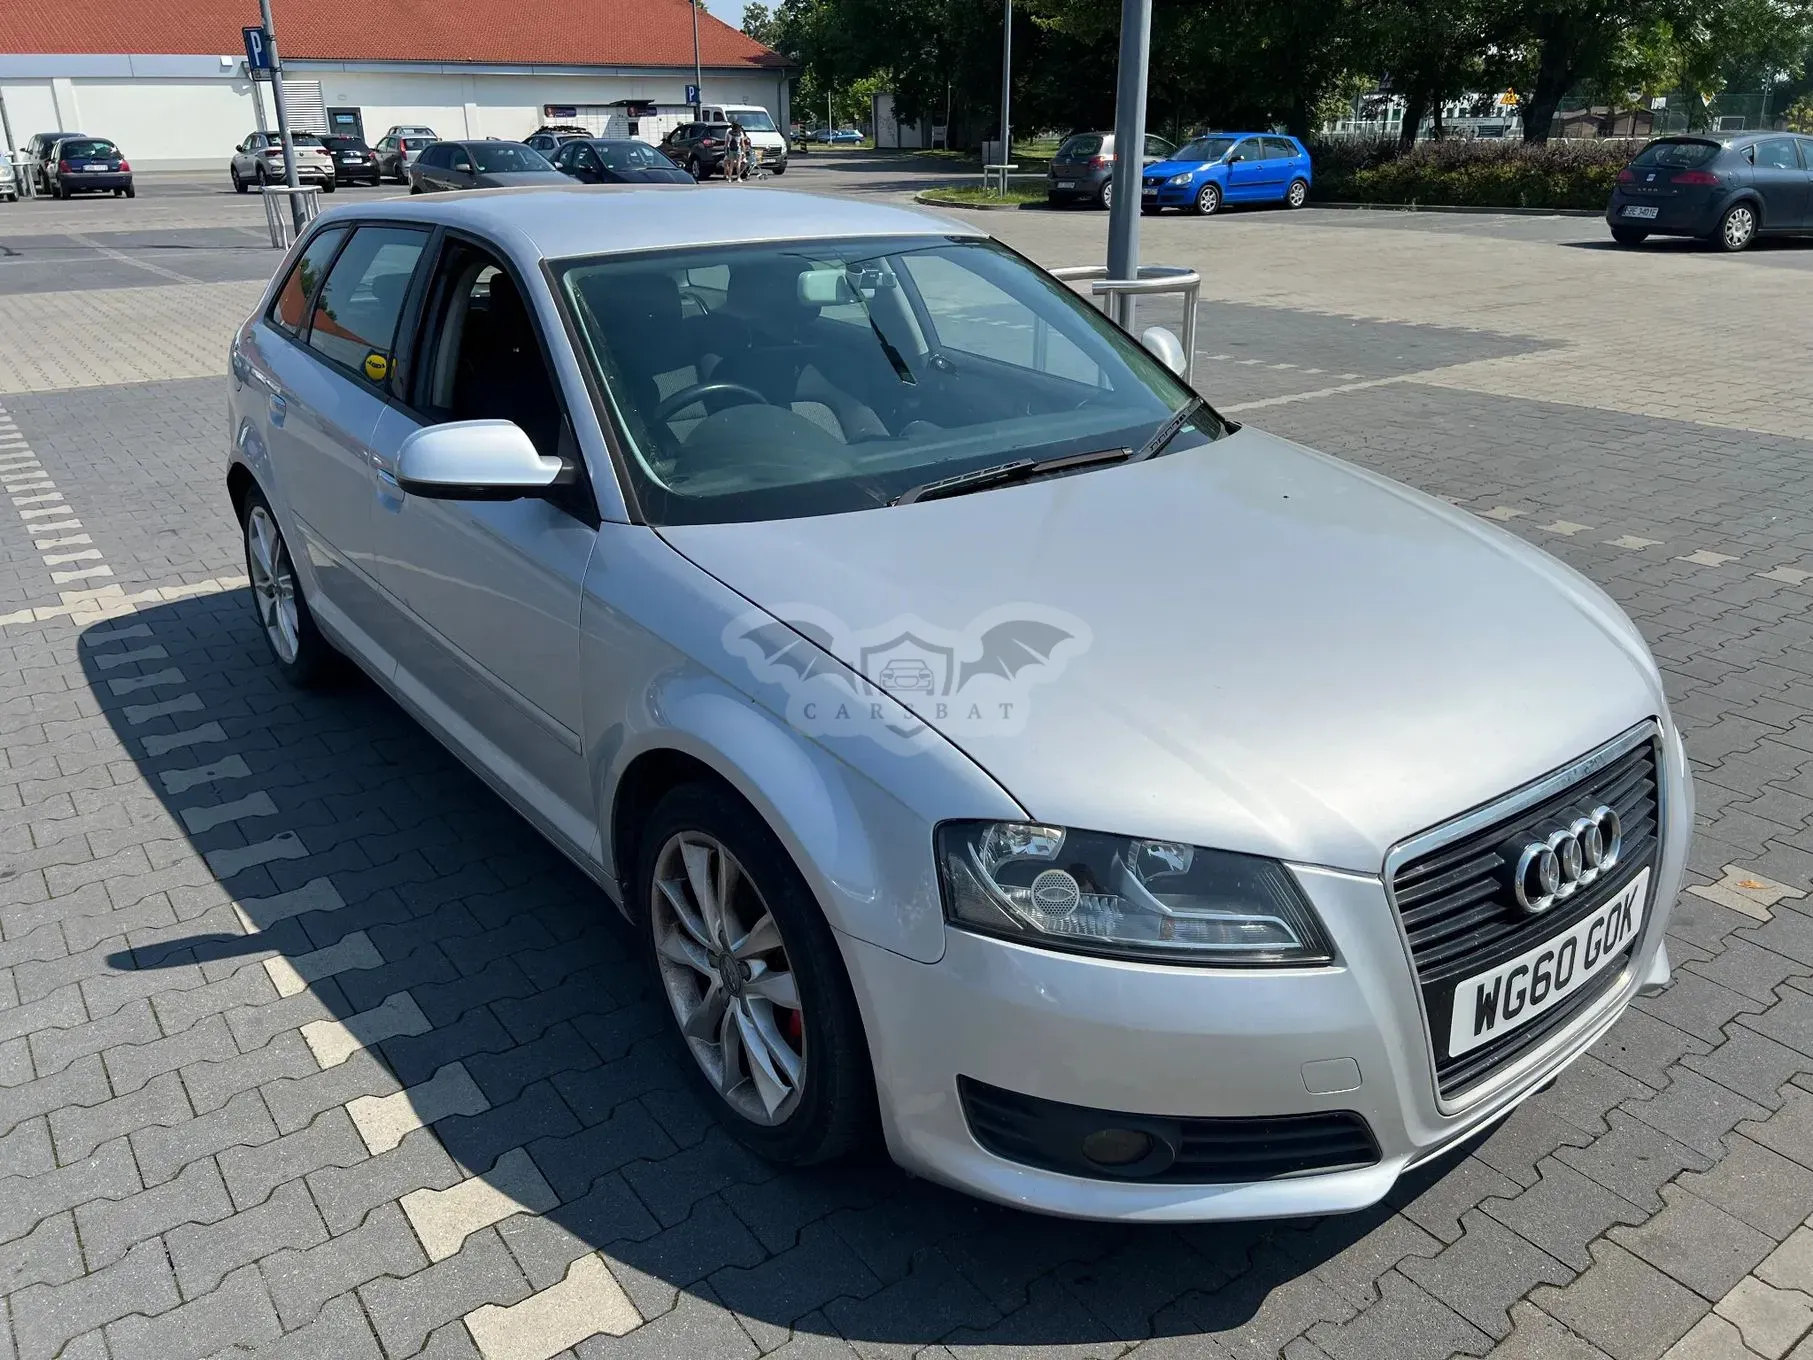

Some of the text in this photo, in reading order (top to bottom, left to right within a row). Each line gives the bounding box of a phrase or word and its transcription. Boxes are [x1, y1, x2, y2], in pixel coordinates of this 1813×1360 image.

[250, 31, 262, 66] P
[688, 86, 695, 102] P
[1473, 935, 1578, 1036] WG60
